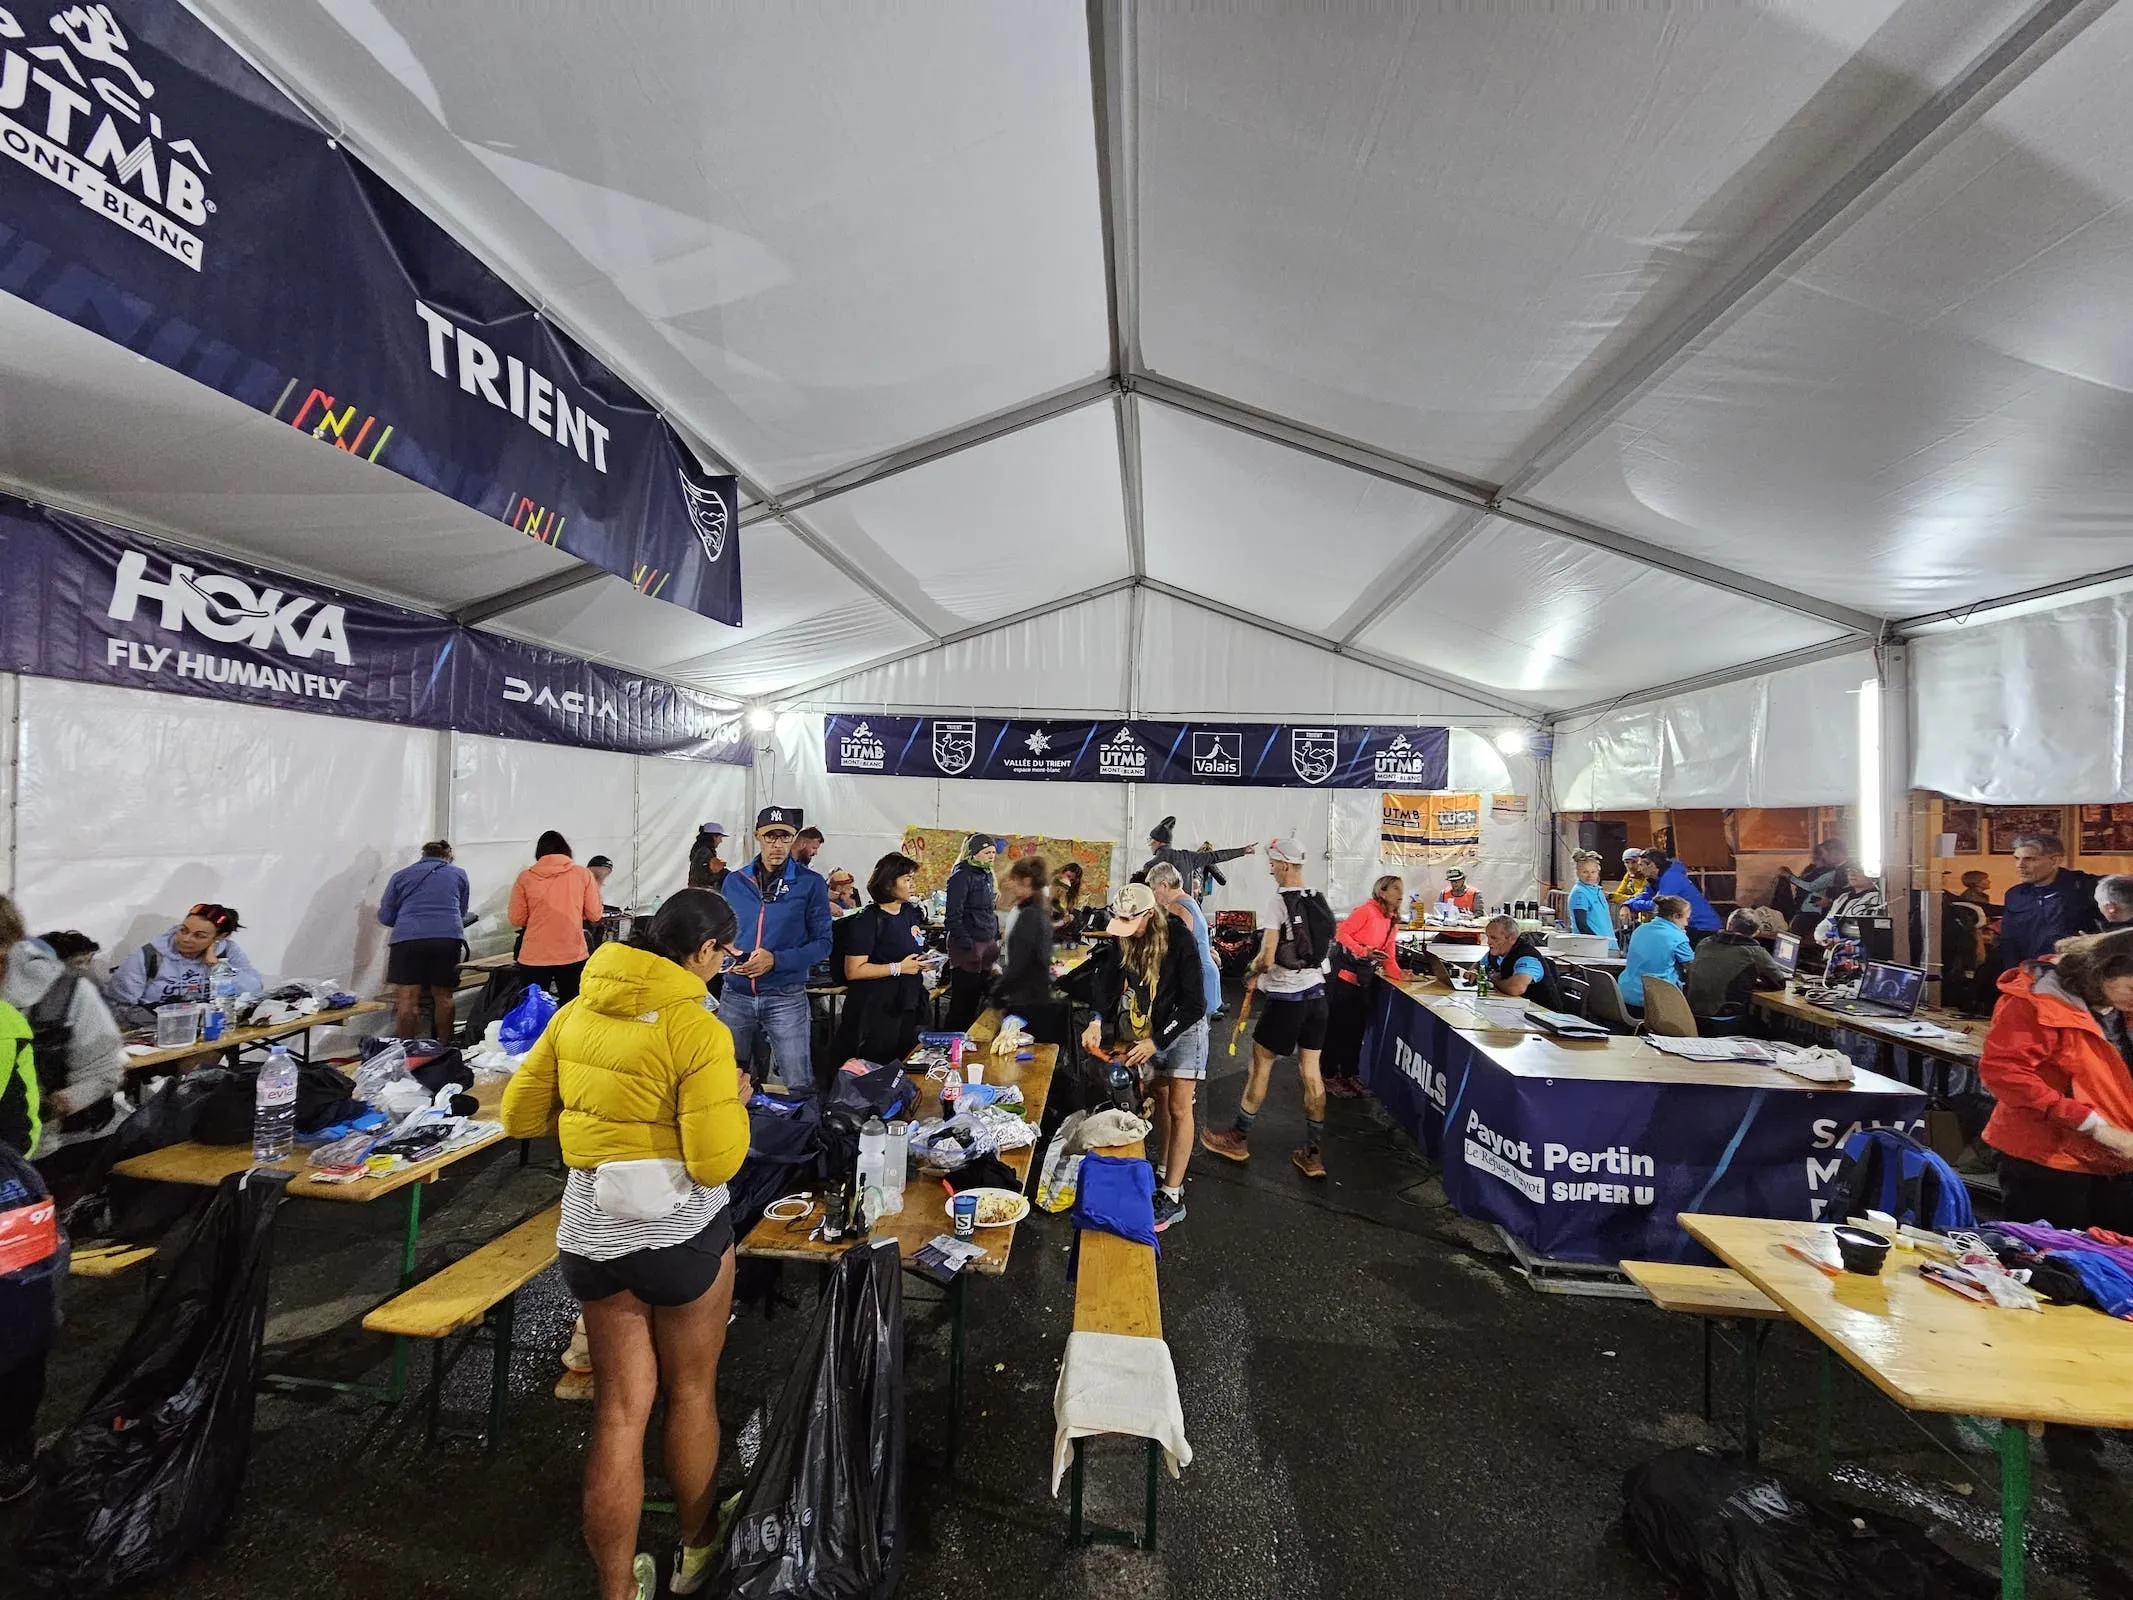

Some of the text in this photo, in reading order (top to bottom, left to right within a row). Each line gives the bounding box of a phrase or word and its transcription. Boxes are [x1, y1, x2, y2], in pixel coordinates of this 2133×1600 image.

[0, 128, 195, 260] ONT-BLANC
[415, 299, 610, 474] TRIENT
[108, 550, 351, 666] HOKA
[107, 638, 352, 701] FLY HUMAN FLY
[502, 676, 619, 721] DACIA
[841, 736, 883, 746] DACIA
[1003, 758, 1031, 767] VALLÉE
[1046, 760, 1072, 768] TRIENT
[1196, 759, 1237, 773] Valais
[1375, 750, 1424, 758] DACIA
[1383, 807, 1420, 820] UTMB
[1394, 1036, 1447, 1107] TRAILS
[267, 1088, 296, 1100] evia
[1465, 1108, 1655, 1177] Payot Pertin
[1465, 1143, 1479, 1158] Le
[1551, 1181, 1655, 1206] SUPER U
